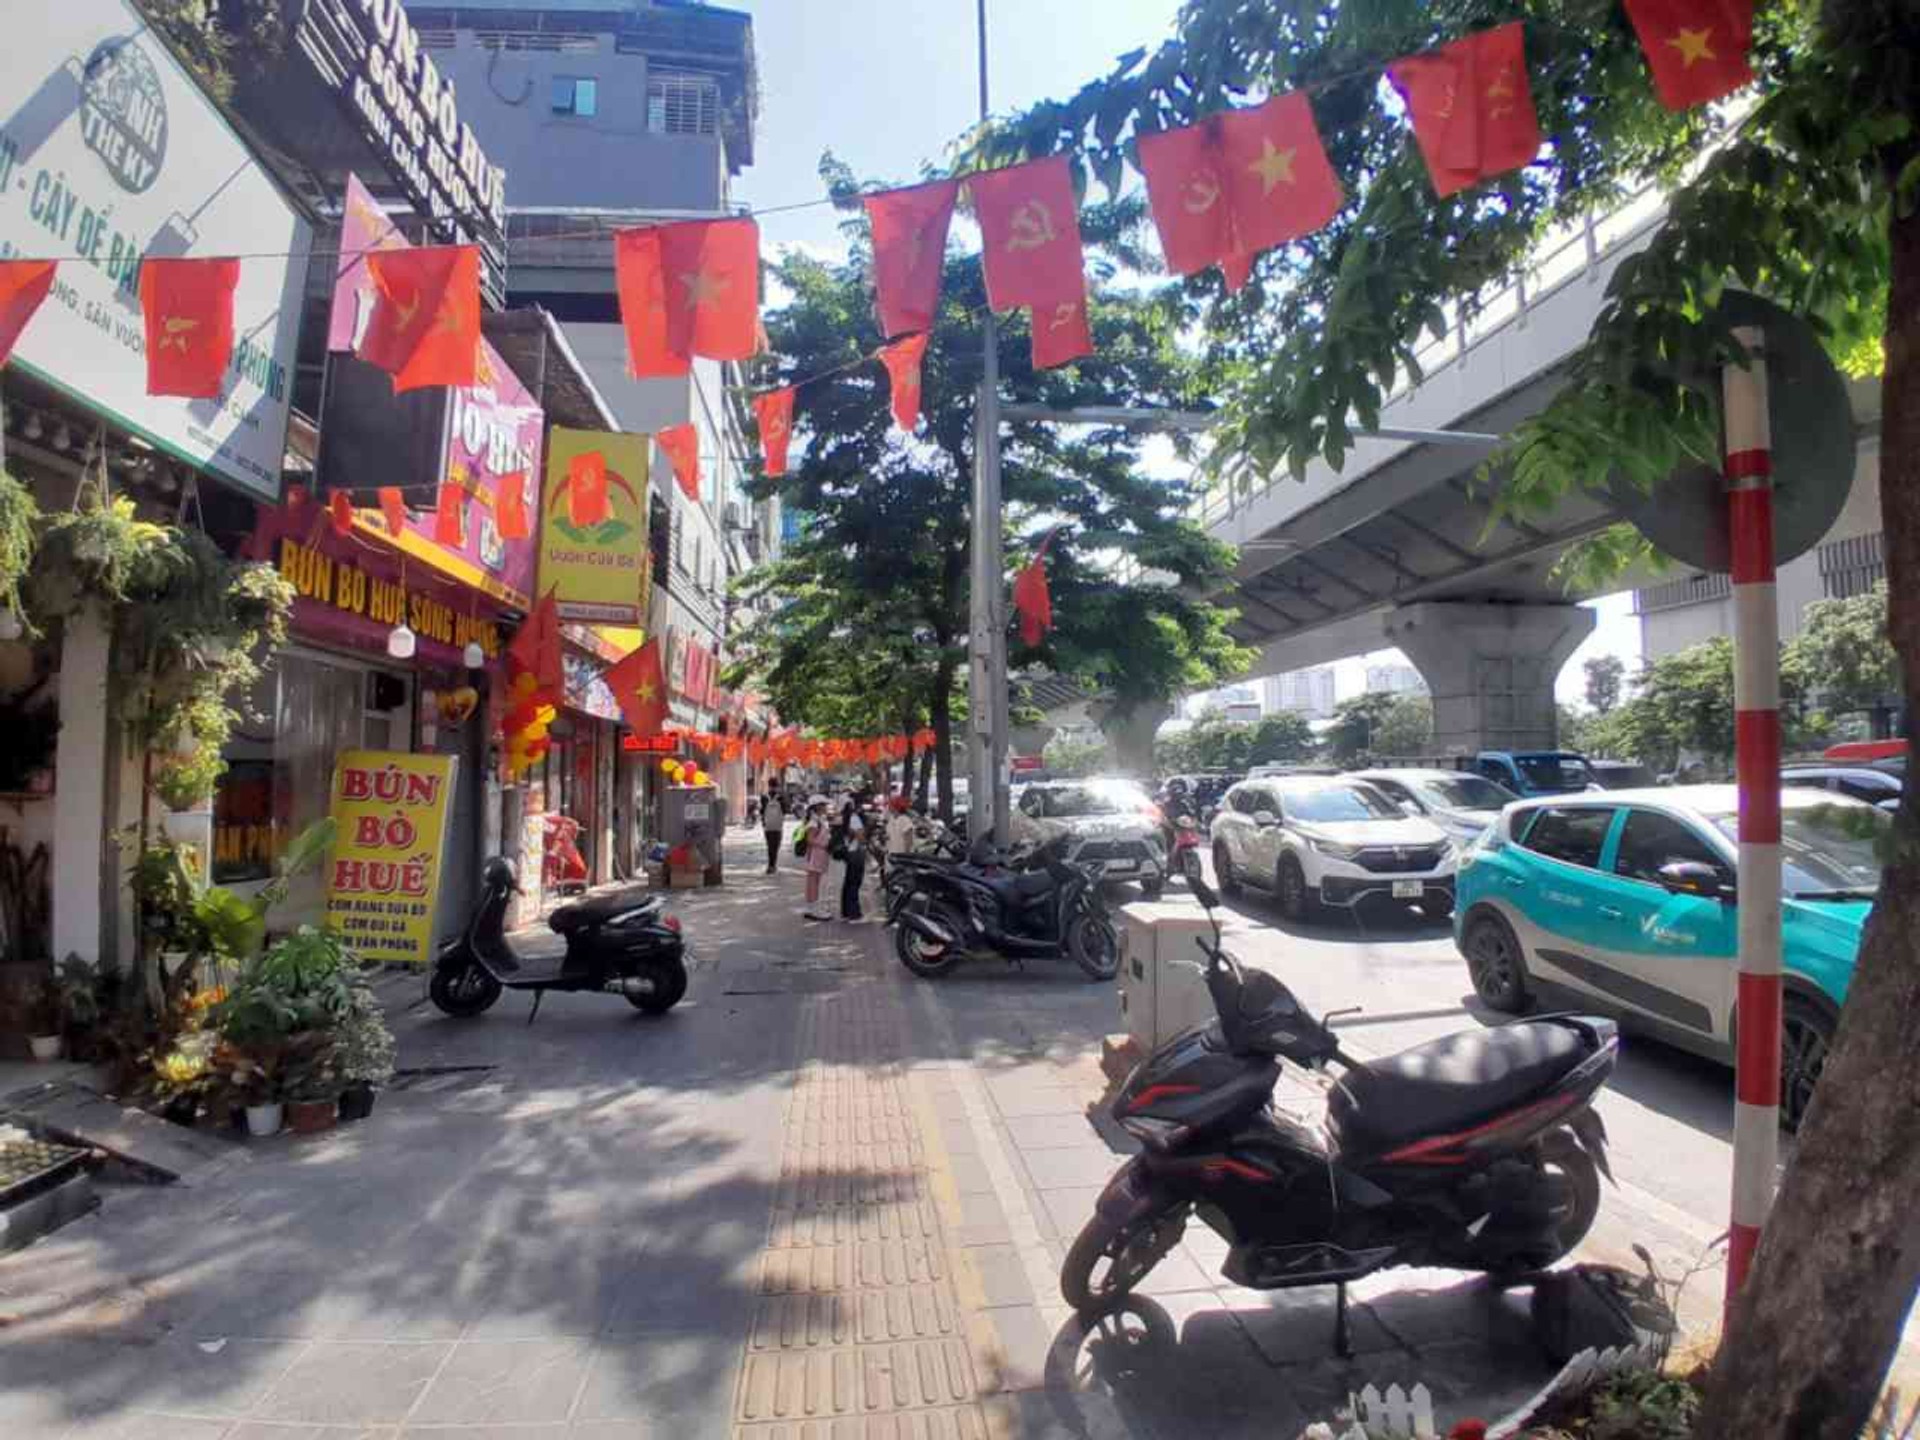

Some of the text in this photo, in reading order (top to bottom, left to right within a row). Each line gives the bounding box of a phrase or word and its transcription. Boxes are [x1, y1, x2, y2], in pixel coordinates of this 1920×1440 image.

[341, 763, 440, 805] BÚN
[354, 809, 417, 849] BÒ
[334, 852, 432, 897] HUẾ
